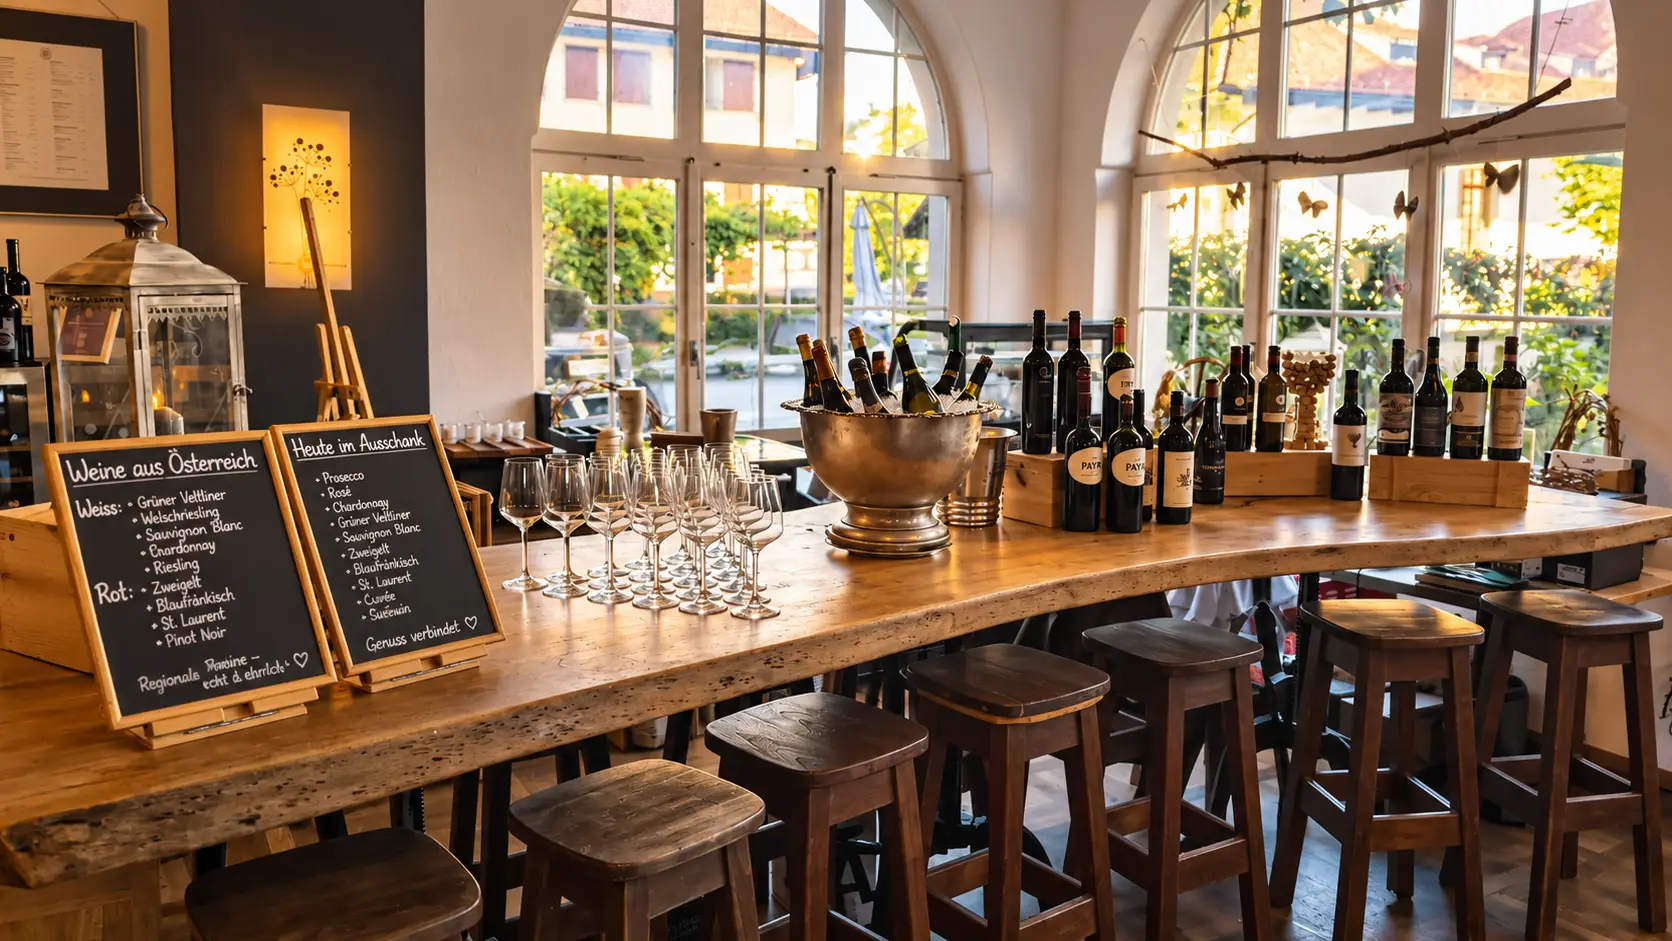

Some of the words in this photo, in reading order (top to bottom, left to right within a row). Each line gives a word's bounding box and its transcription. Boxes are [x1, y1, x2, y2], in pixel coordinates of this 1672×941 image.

[291, 437, 335, 459] Heute
[338, 438, 355, 454] im
[359, 429, 426, 452] Ausschank
[66, 458, 126, 483] Weine
[133, 461, 164, 478] aus
[168, 448, 258, 475] Österreich
[322, 471, 365, 484] Prosecco
[327, 485, 352, 499] Rosé
[75, 498, 122, 519] Weiss:
[137, 495, 177, 508] Grüner
[179, 489, 226, 504] Veltliner
[140, 505, 220, 525] Welschriesling
[145, 526, 207, 542] Sauvignon
[210, 520, 244, 533] Blanc
[342, 529, 392, 543] Sauvignon
[394, 523, 421, 535] Blanc
[347, 542, 390, 559] Zweigelt
[153, 558, 200, 574] Riesling
[93, 580, 134, 605] Rot:
[151, 575, 202, 595] Zweigelt
[358, 577, 374, 591] St.
[376, 570, 412, 588] Laurent
[161, 615, 178, 631] St.
[180, 606, 227, 628] Laurent
[165, 630, 197, 648] Pinot
[200, 626, 227, 641] Noir
[366, 633, 407, 653] Genuss
[410, 619, 461, 643] verbindet
